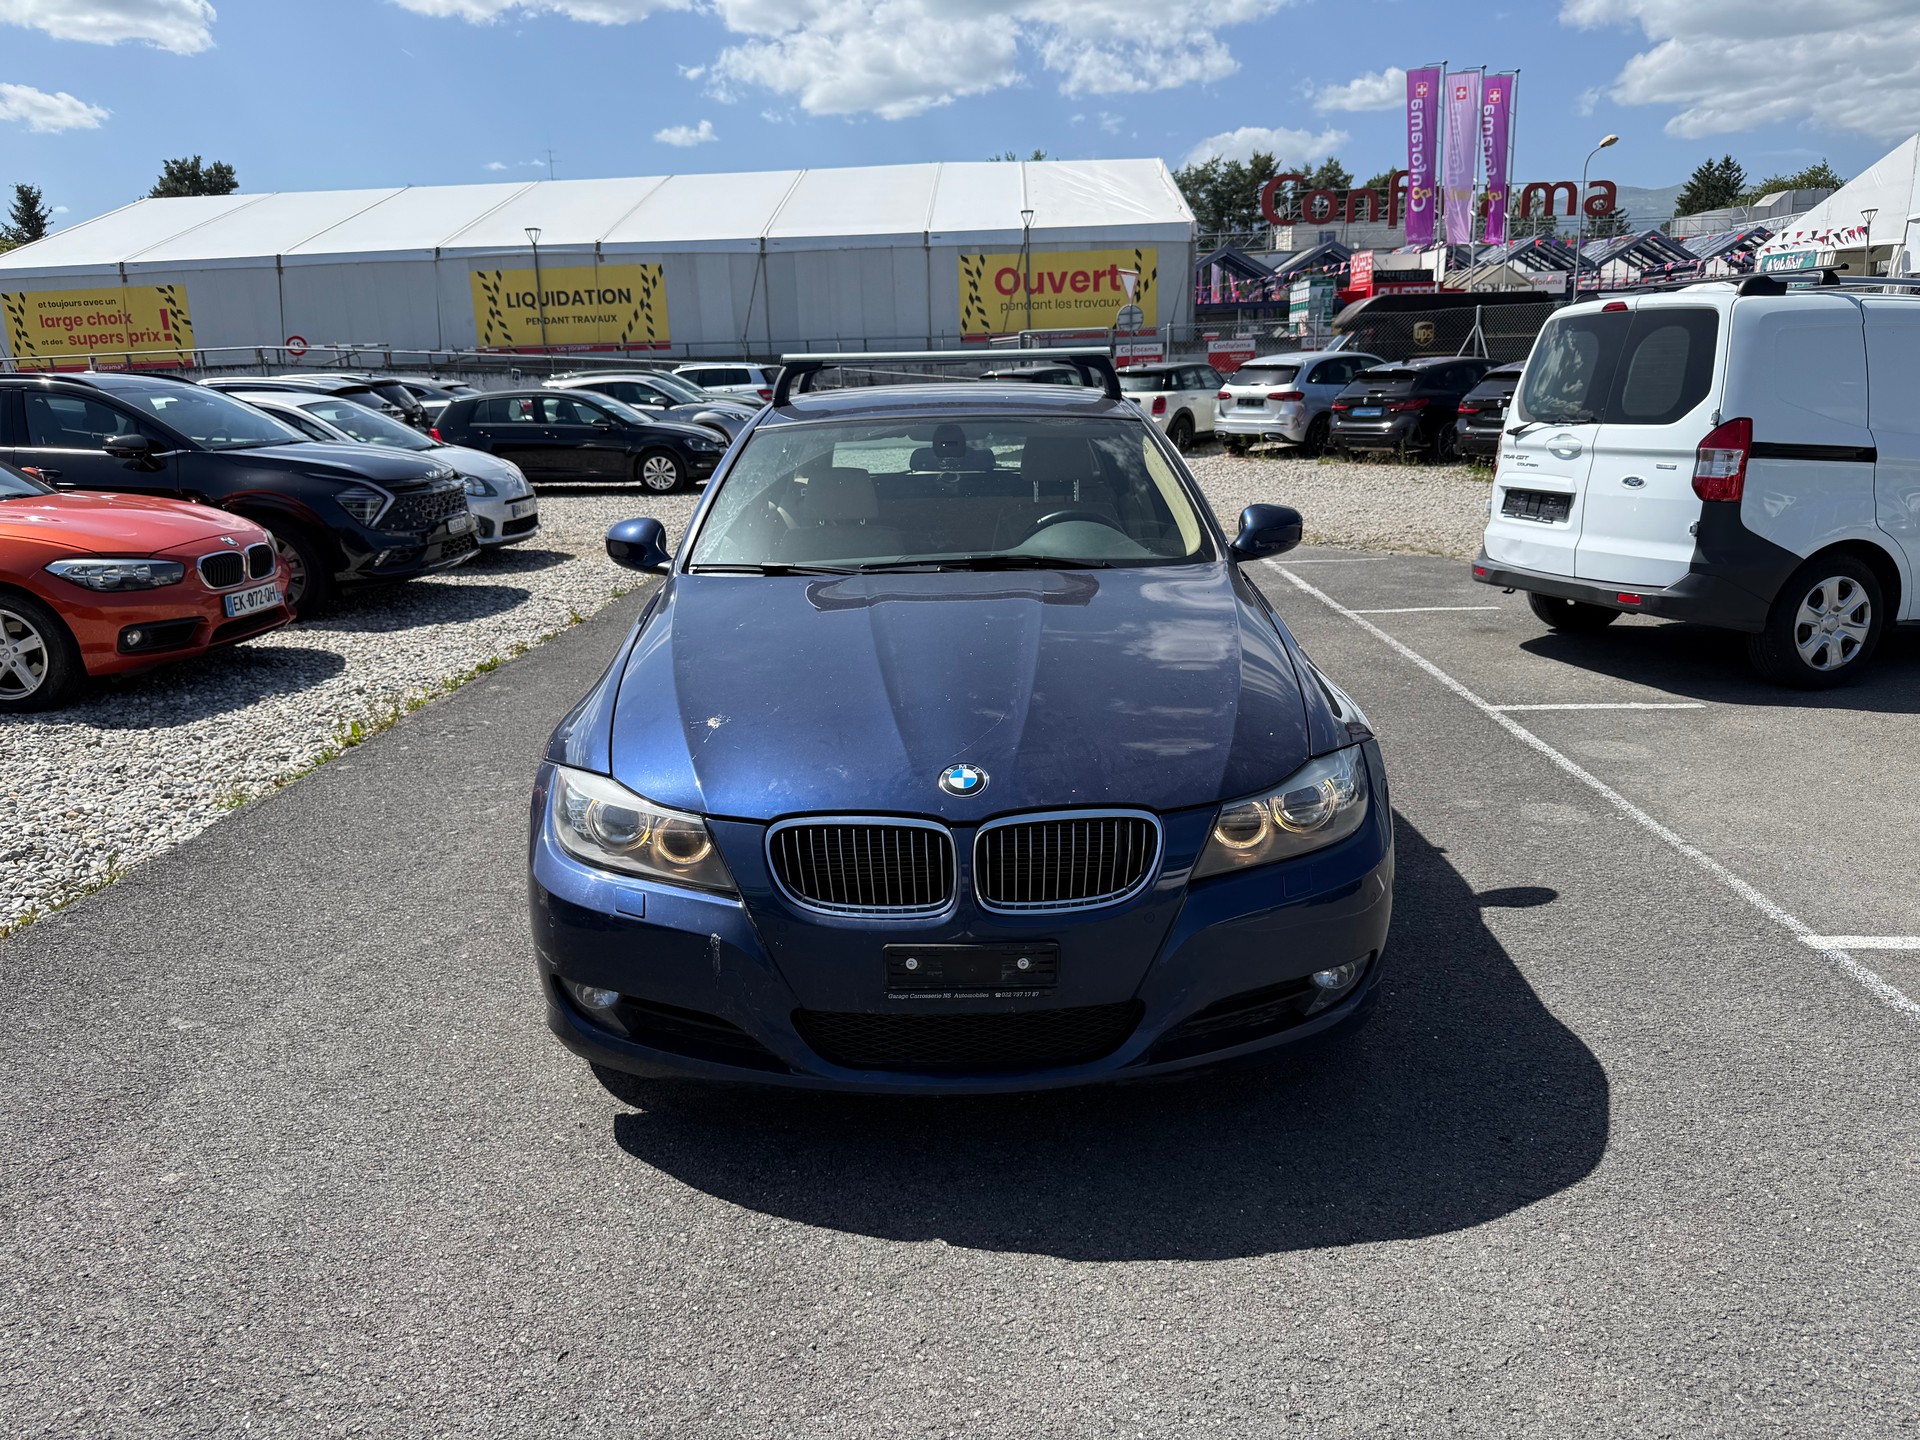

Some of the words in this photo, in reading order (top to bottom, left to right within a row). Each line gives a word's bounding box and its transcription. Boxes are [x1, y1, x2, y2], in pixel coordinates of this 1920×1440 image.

[1261, 169, 1617, 229] Confma
[994, 264, 1121, 296] Ouvert
[38, 301, 47, 309] et
[47, 299, 82, 310] toujours
[83, 299, 104, 307] avec
[104, 298, 117, 306] un
[506, 288, 632, 310] LIQUIDATION
[1000, 299, 1053, 314] pendant
[1055, 298, 1072, 309] les
[1074, 297, 1121, 309] travaux
[39, 313, 84, 332] large
[86, 310, 134, 326] choix
[525, 315, 570, 326] PENDANT
[572, 314, 618, 324] TRAVAUX
[49, 338, 64, 346] des
[68, 331, 125, 349] supers
[128, 327, 161, 348] prix
[1120, 346, 1159, 354] Coforama
